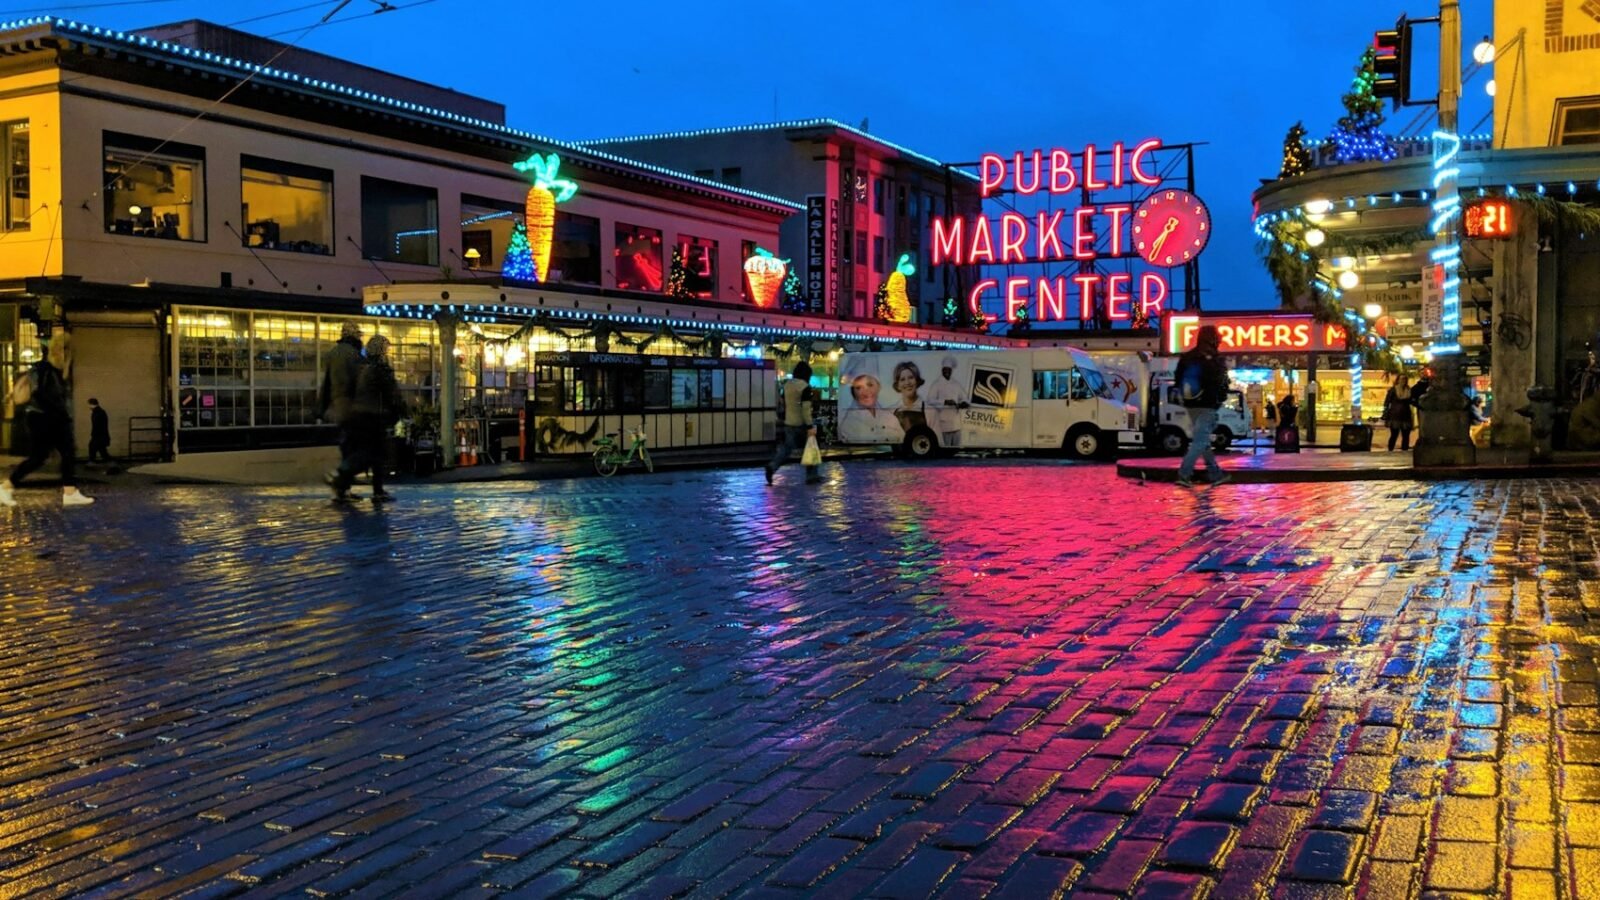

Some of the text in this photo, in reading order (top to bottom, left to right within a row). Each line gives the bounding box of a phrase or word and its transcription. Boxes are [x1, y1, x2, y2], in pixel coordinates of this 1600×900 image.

[981, 138, 1162, 197] PUBLIC
[1166, 192, 1175, 200] 12
[1185, 195, 1188, 203] 1
[811, 200, 822, 216] LA
[832, 200, 837, 218] LA
[1195, 206, 1201, 214] 2
[1200, 222, 1205, 230] 3
[1483, 205, 1506, 233] 21
[931, 204, 1132, 265] MARKET
[810, 220, 822, 266] SALLE
[1166, 256, 1172, 264] 6
[1184, 251, 1189, 259] 5
[969, 271, 1168, 323] CENTER
[1183, 324, 1309, 347] FRMERS
[964, 409, 1006, 425] SERVICE
